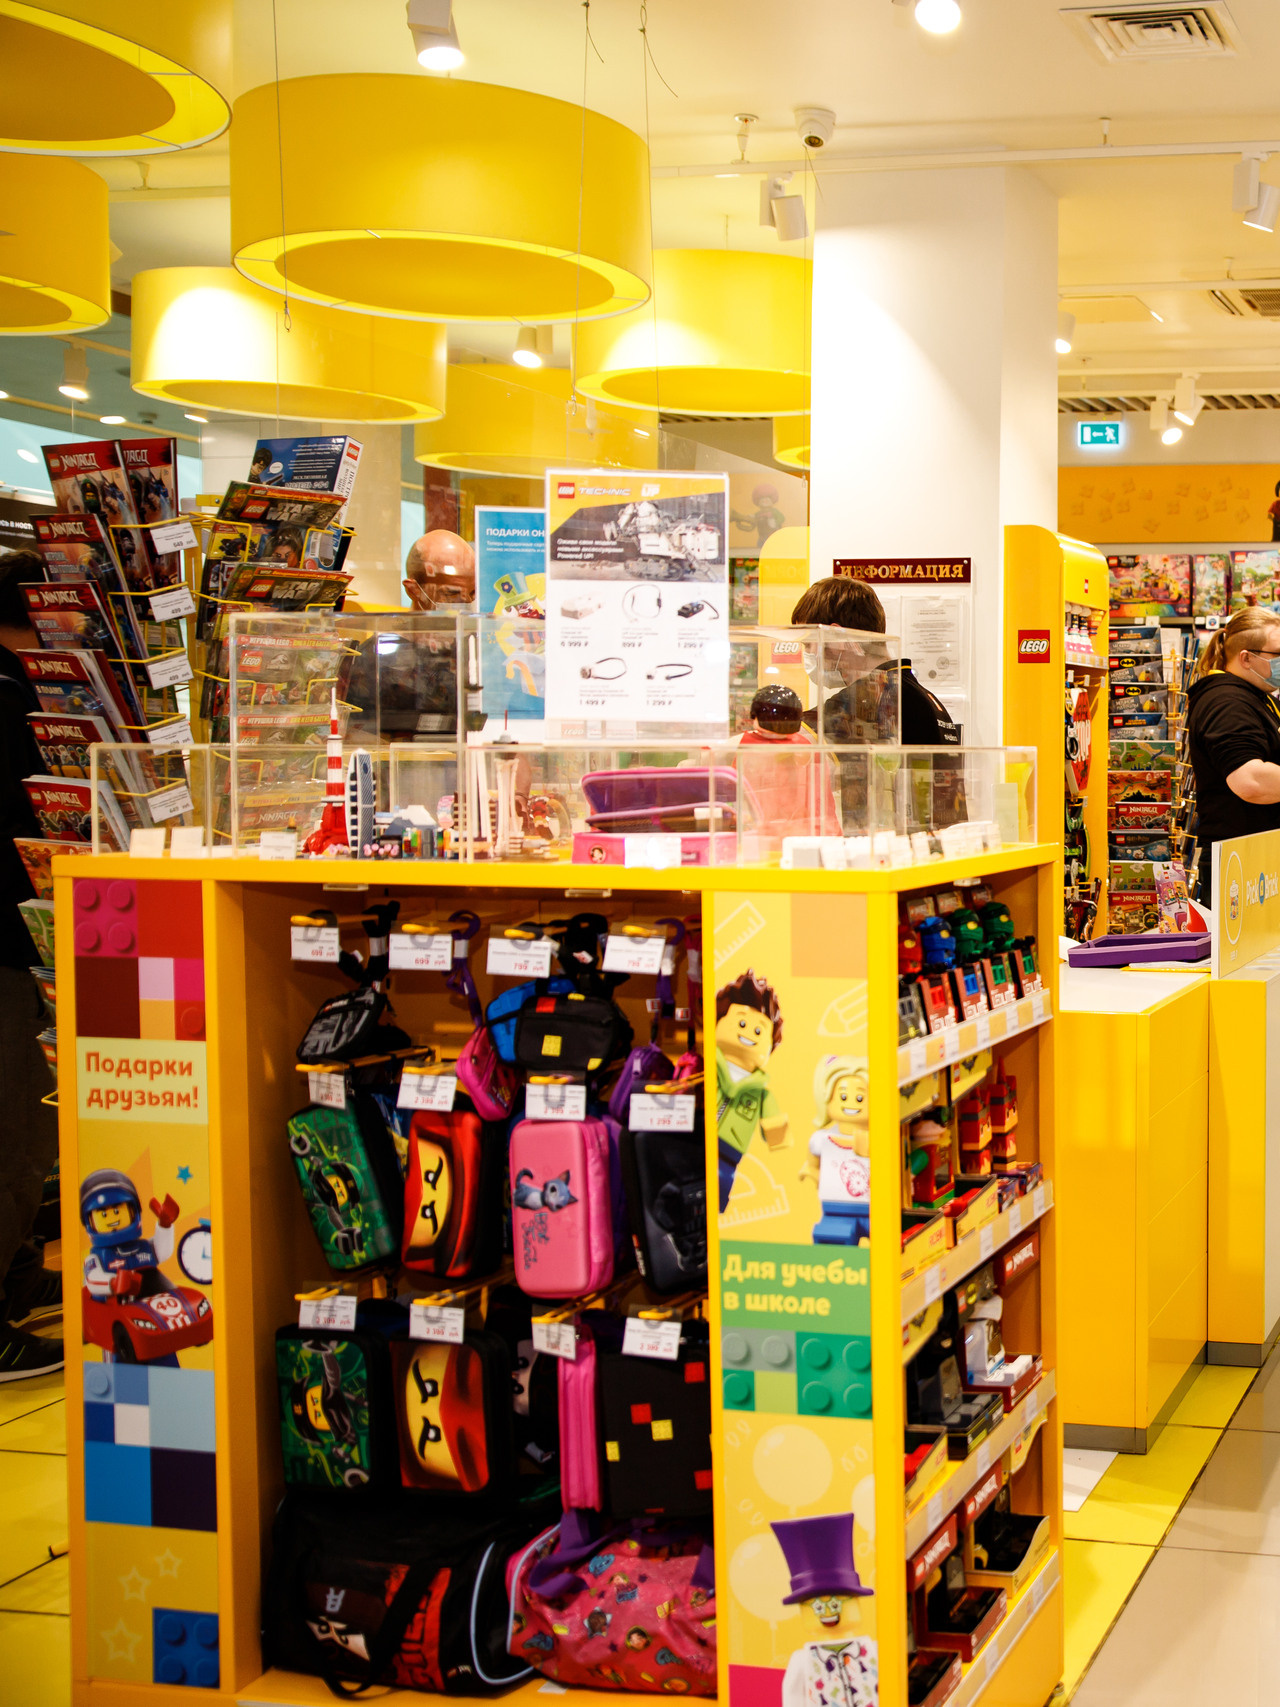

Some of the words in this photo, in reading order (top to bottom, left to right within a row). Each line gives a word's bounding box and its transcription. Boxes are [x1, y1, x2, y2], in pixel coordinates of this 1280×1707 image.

[60, 453, 100, 471] NINJAGO
[578, 487, 632, 496] TECHNIC
[49, 522, 90, 538] NINJAGO
[486, 528, 530, 538] ПОДАРКИ
[841, 564, 964, 582] ИНФОРМАЦИЯ
[39, 591, 85, 607] NINJAGO
[774, 642, 799, 654] LEGO
[1020, 640, 1048, 653] LEGO
[36, 660, 77, 677] NINJAGO
[241, 656, 261, 665] LEGO
[46, 724, 88, 741] NINJAGO
[41, 791, 85, 808] NINJAGO
[1129, 806, 1158, 814] NINJAGO
[1246, 881, 1260, 907] Pick
[1265, 871, 1279, 900] Brick
[85, 1052, 193, 1081] Подарки
[86, 1085, 199, 1111] друзьям!
[723, 1254, 777, 1283] Для
[781, 1258, 869, 1287] учебы
[723, 1291, 740, 1311] в
[743, 1292, 831, 1318] школе
